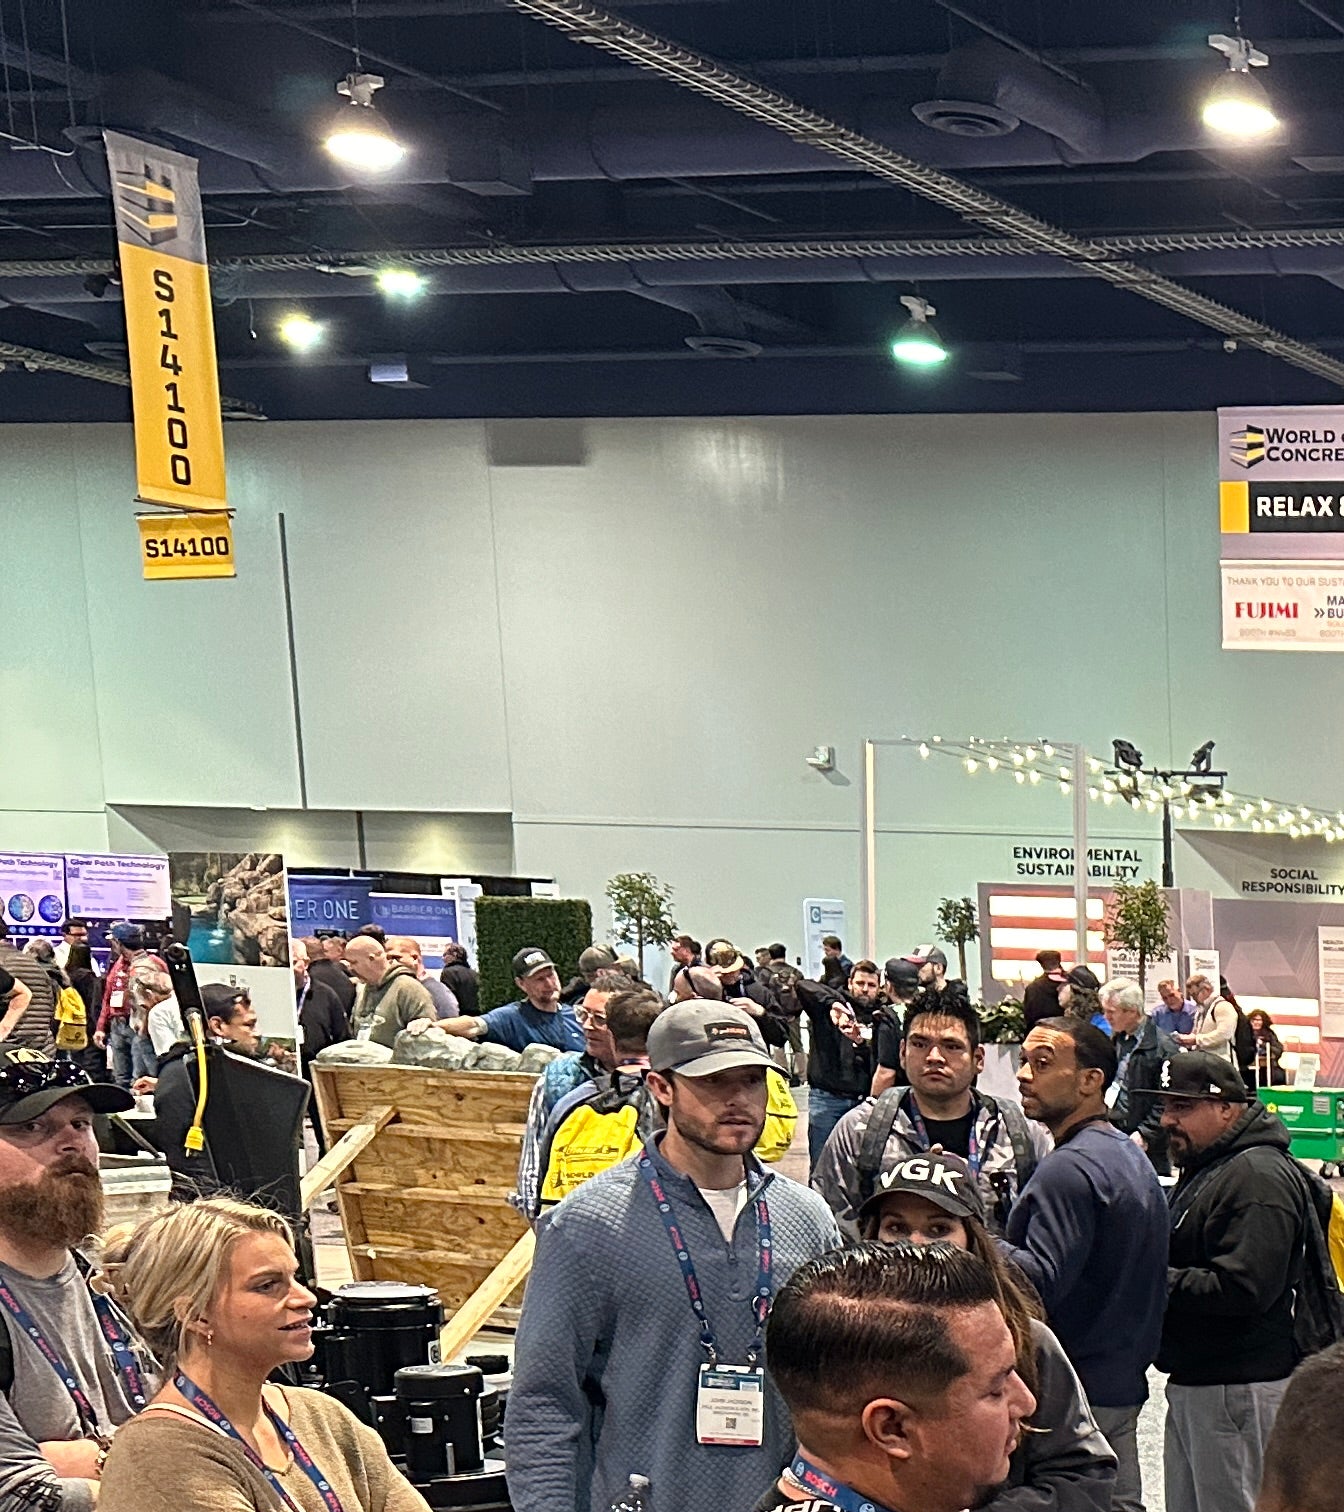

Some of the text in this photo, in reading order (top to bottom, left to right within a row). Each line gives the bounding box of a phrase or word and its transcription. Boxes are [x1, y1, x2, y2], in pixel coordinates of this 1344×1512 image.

[152, 268, 192, 487] S14100
[1265, 428, 1336, 444] WORLD
[1256, 496, 1334, 517] RELAX
[145, 539, 230, 560] S14100
[1227, 576, 1257, 586] THANK
[1261, 577, 1279, 586] YOU
[1282, 577, 1294, 586] TO
[1296, 577, 1316, 586] OUR
[1235, 602, 1299, 619] FUJIMI
[1013, 846, 1142, 863] ENVIROMENTAL
[117, 861, 166, 870] Technology
[1270, 868, 1319, 881] SOCIAL
[323, 900, 361, 919] ONE
[435, 906, 454, 916] ONE
[881, 1159, 963, 1196] VGK
[804, 1470, 839, 1497] BOSCH
